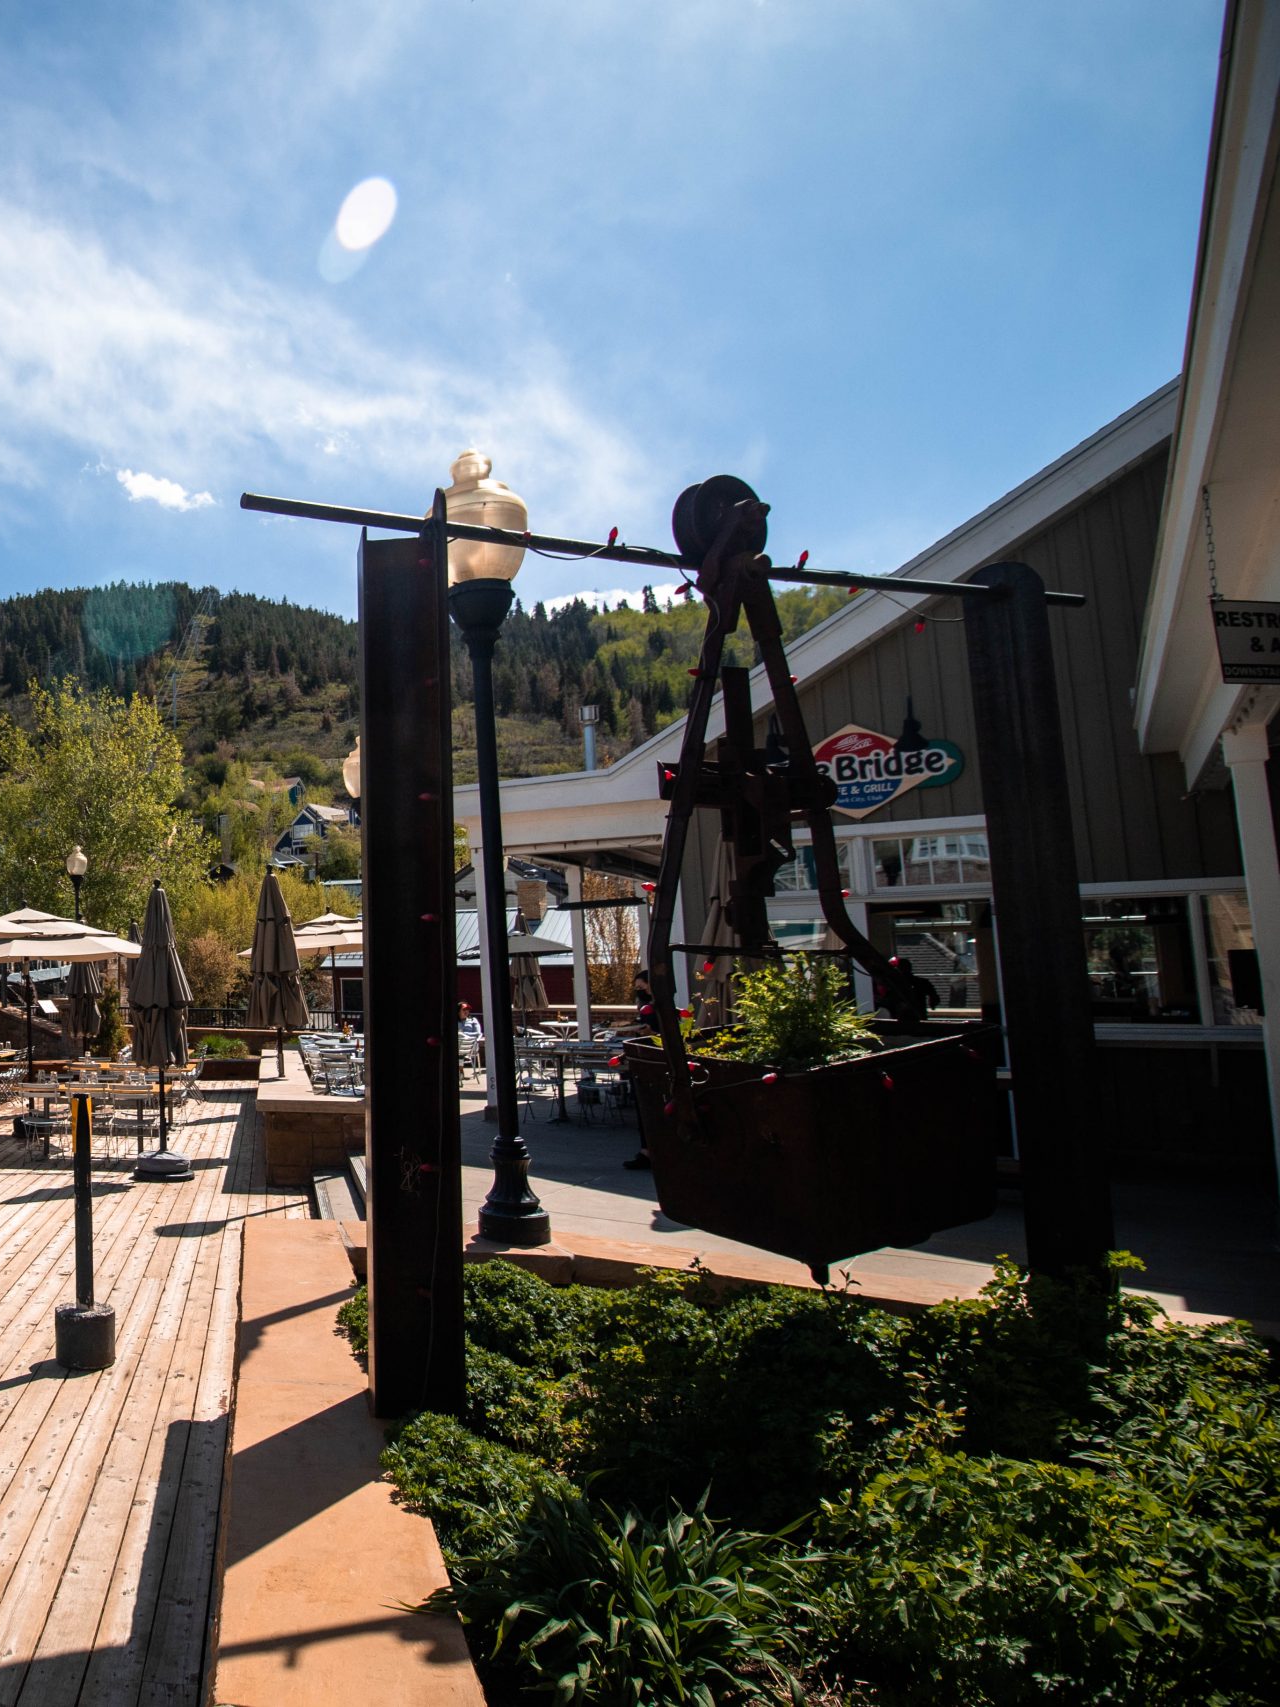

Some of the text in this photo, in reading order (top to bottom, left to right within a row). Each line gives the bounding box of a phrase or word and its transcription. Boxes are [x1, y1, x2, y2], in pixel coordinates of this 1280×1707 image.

[1215, 611, 1280, 628] RESTR
[1250, 636, 1265, 652] &
[835, 751, 945, 781] Bridge
[850, 785, 860, 794] &
[863, 782, 894, 793] GRILL
